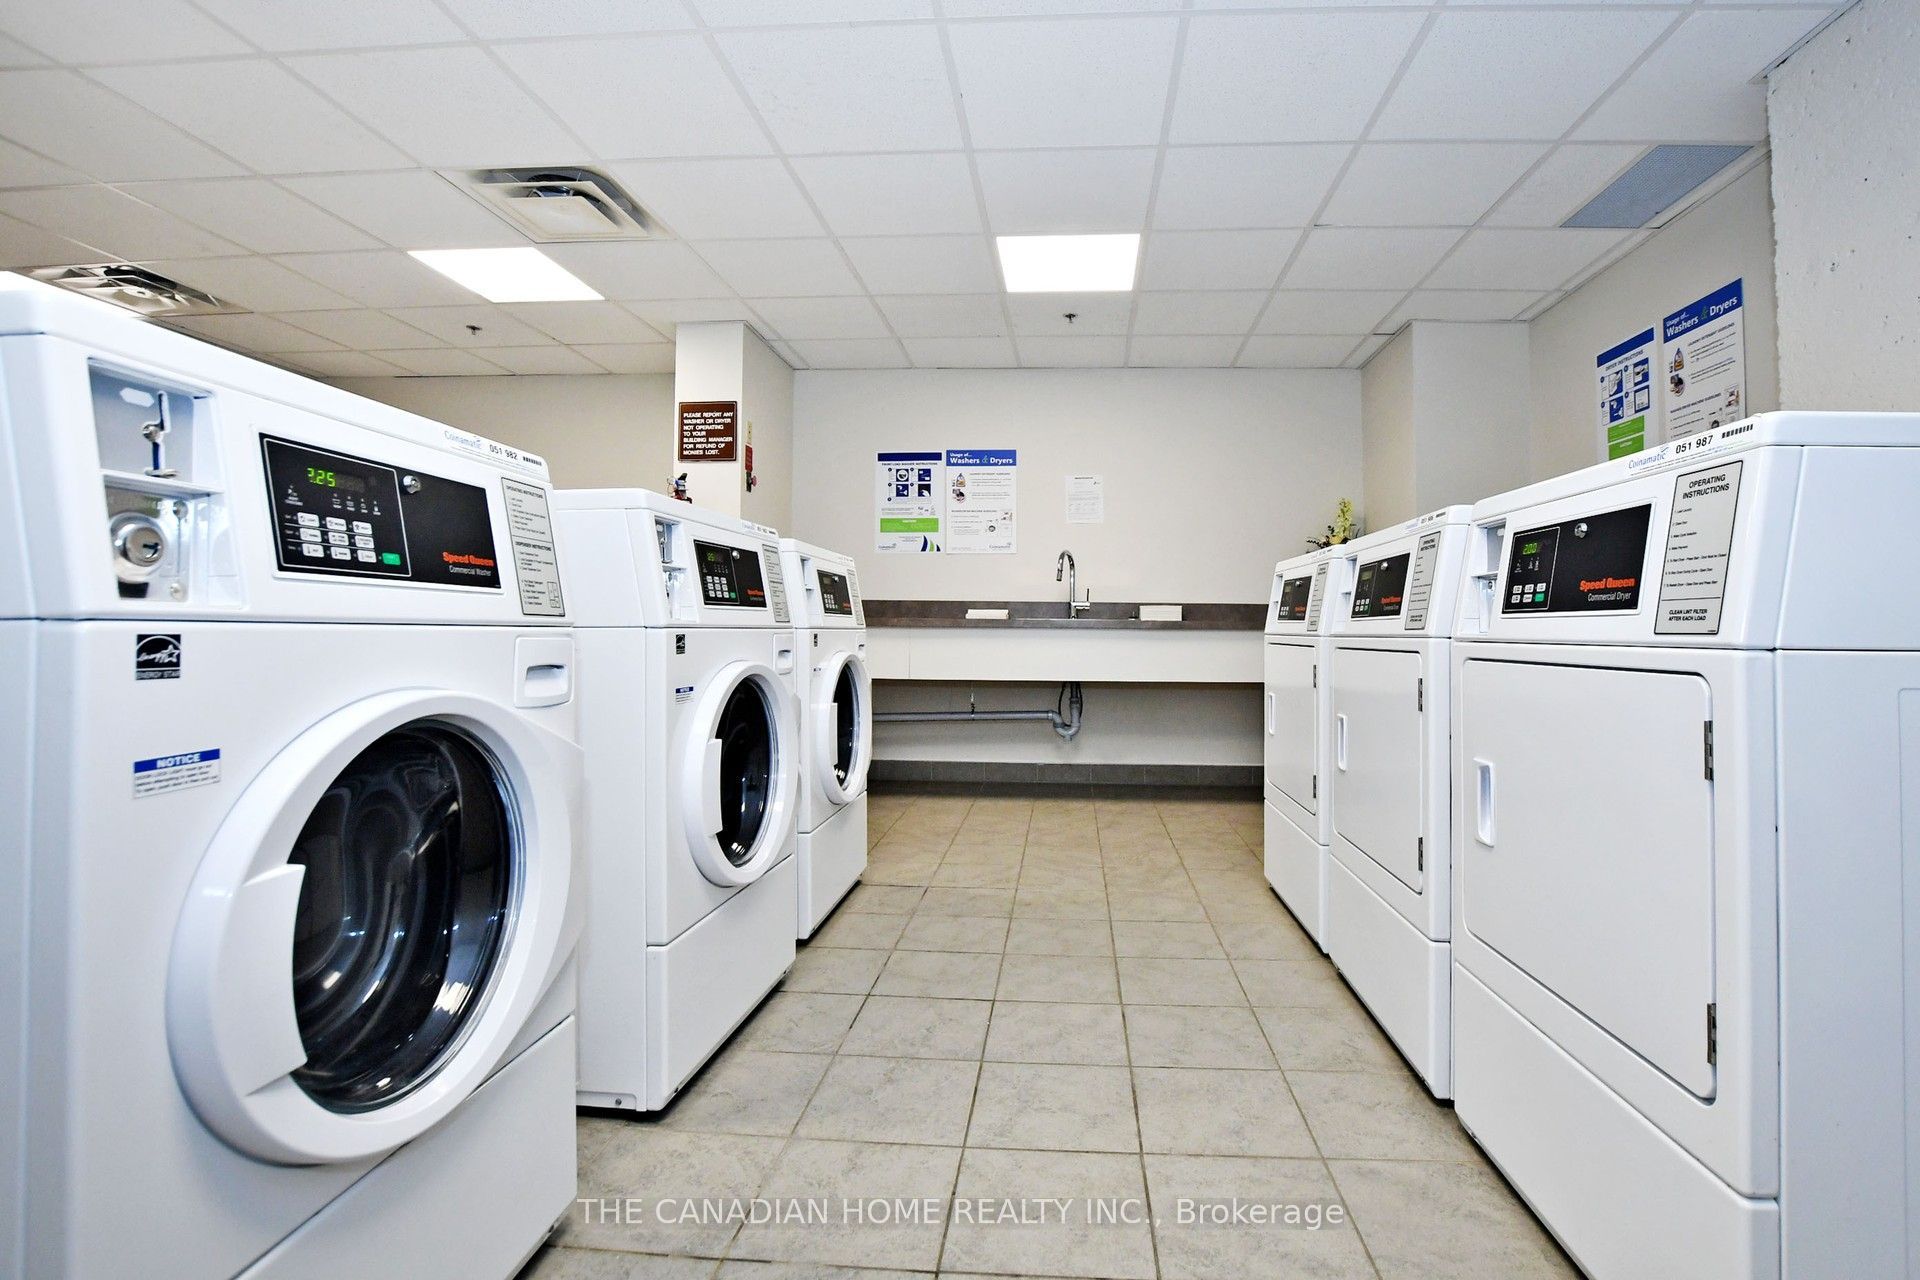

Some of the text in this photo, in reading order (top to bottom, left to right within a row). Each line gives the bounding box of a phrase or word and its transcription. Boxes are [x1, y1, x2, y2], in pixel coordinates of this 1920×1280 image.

[1666, 316, 1698, 337] Washers
[1709, 296, 1738, 316] Dryers
[489, 444, 518, 460] 051 982
[1675, 435, 1714, 454] 051 987
[990, 457, 1013, 465] Dryers
[1628, 451, 1667, 469] Coinamatic
[1689, 473, 1726, 489] OPERATING
[1682, 483, 1730, 499] INSTRUCTIONS
[442, 551, 495, 567] Speed Queen
[449, 564, 492, 577] Commercial Washer
[1579, 577, 1635, 592] Speed Queen
[1587, 591, 1632, 601] Commercial Dryer
[136, 670, 181, 679] ENERGY STAR
[156, 753, 201, 768] NOTICE
